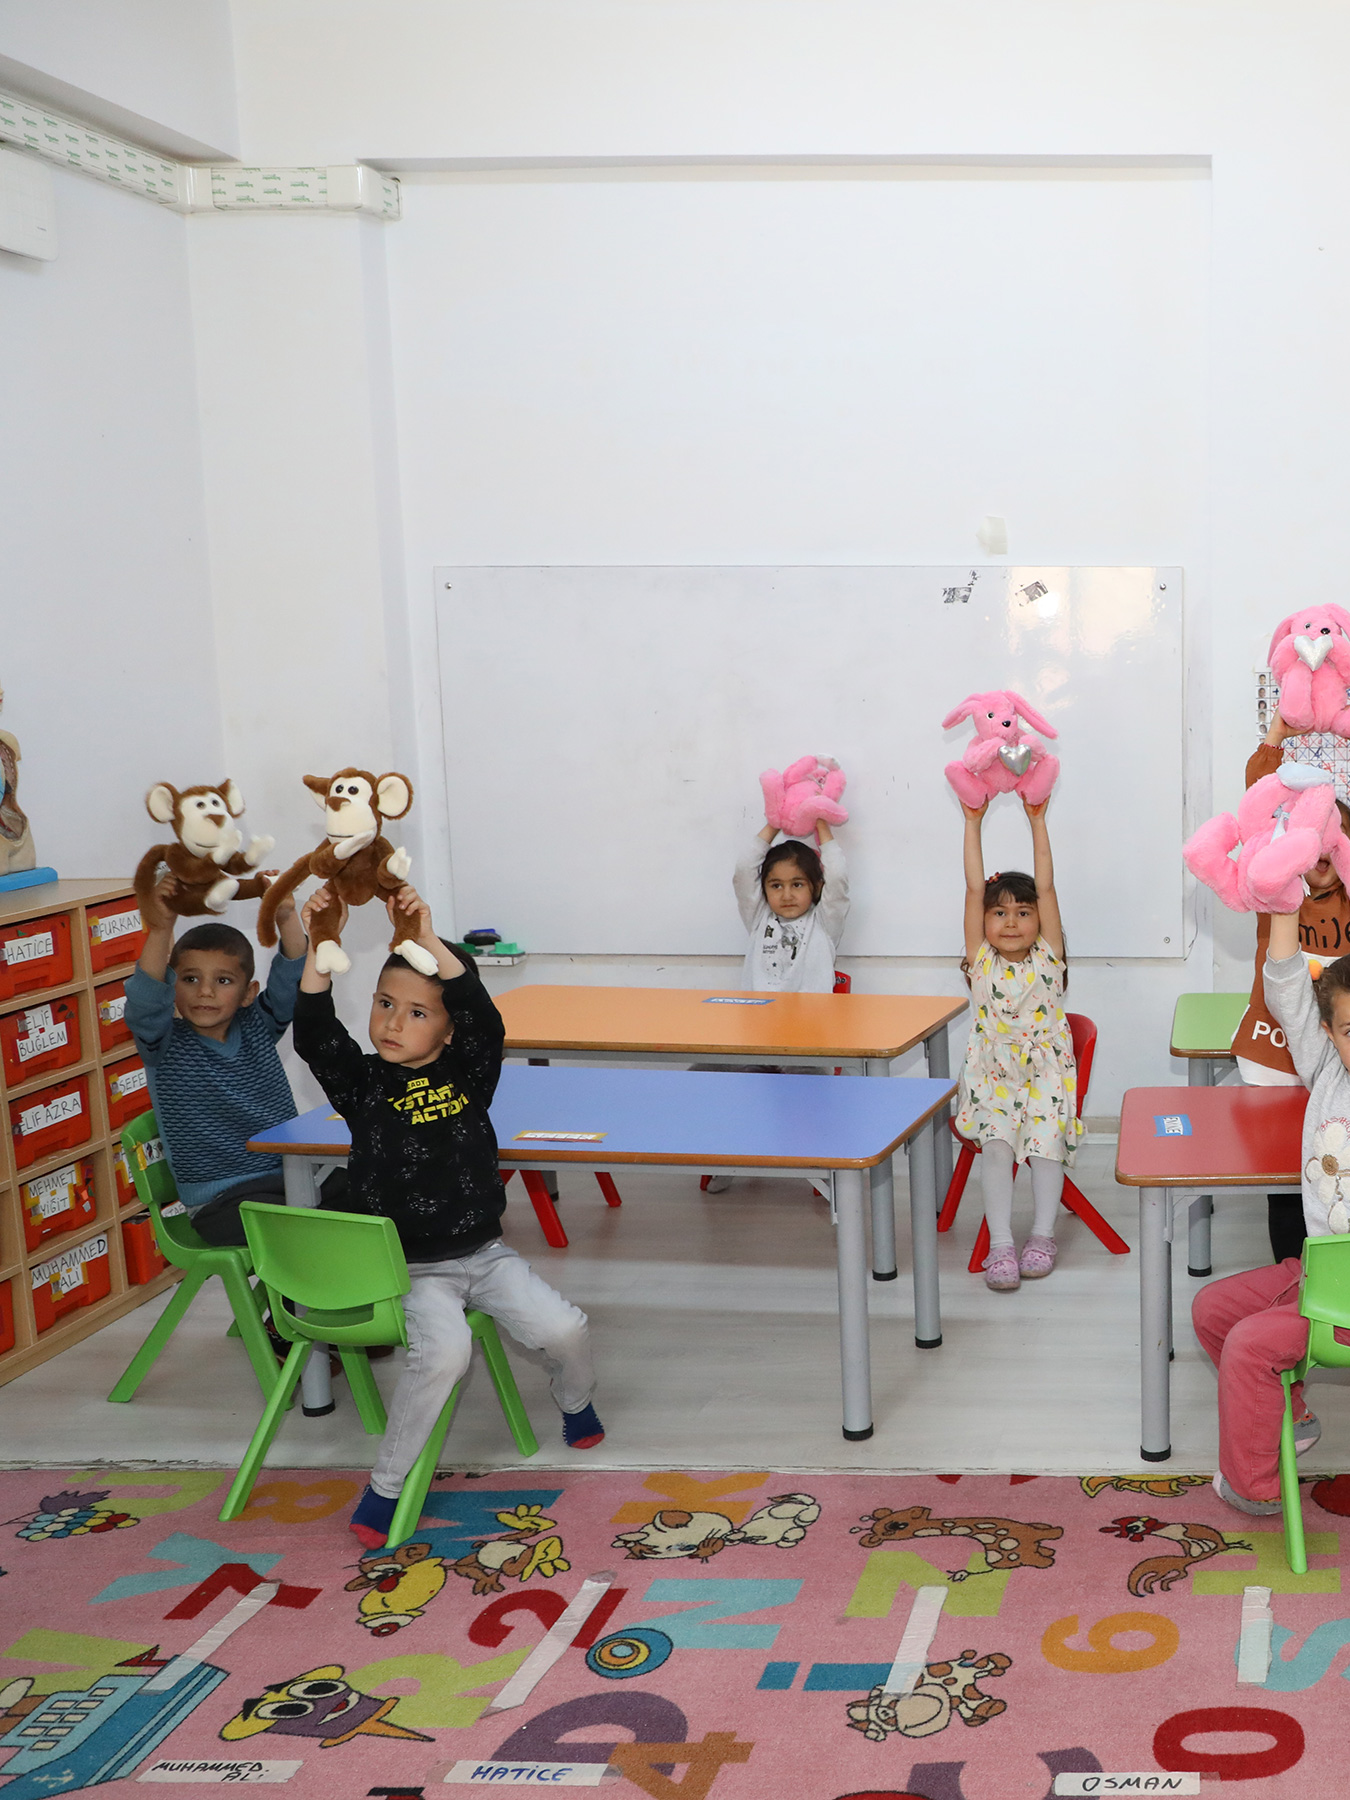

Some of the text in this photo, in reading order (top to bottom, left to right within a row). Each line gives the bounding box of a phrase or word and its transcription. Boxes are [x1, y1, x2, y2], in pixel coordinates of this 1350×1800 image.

[99, 914, 141, 934] FURKAN
[7, 937, 53, 962] HATİCE
[19, 1030, 67, 1058] BUĞLEM
[44, 1097, 81, 1123] AZRA
[29, 1170, 75, 1197] MEHMET
[32, 1239, 106, 1283] MUHAMMED
[470, 1765, 573, 1781] HATİCE
[1082, 1776, 1183, 1792] OSMAN
